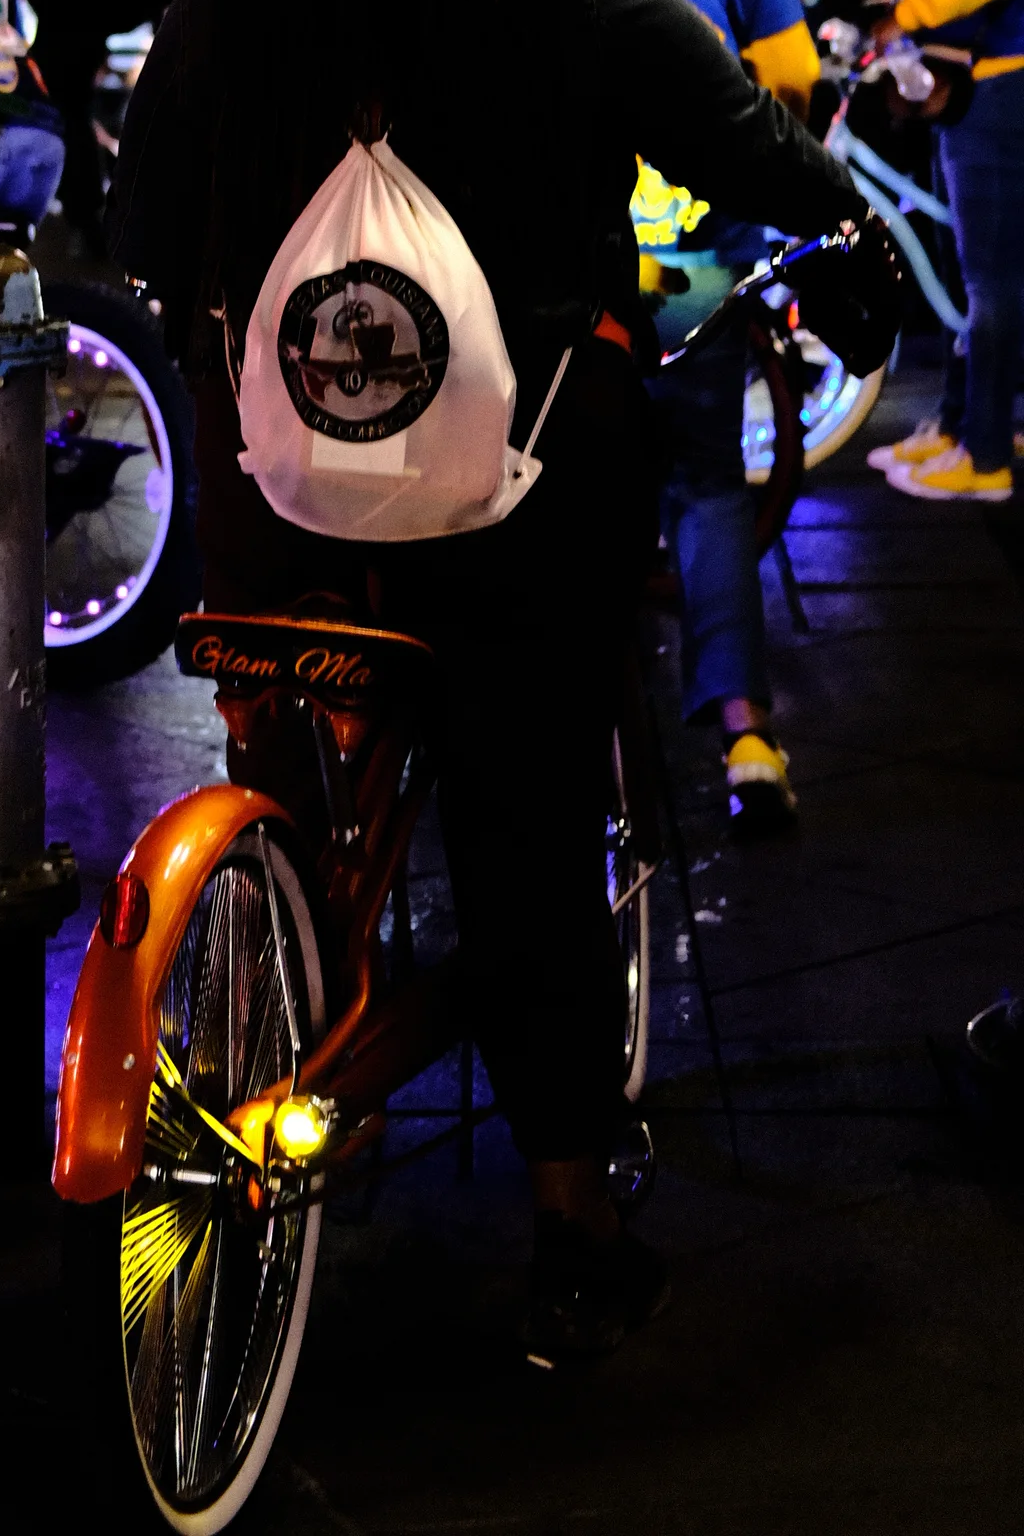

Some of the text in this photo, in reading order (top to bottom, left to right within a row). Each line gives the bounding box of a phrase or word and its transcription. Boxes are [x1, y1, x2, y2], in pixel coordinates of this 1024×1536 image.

[343, 368, 363, 390] 10
[191, 634, 373, 687] Glam Ma
